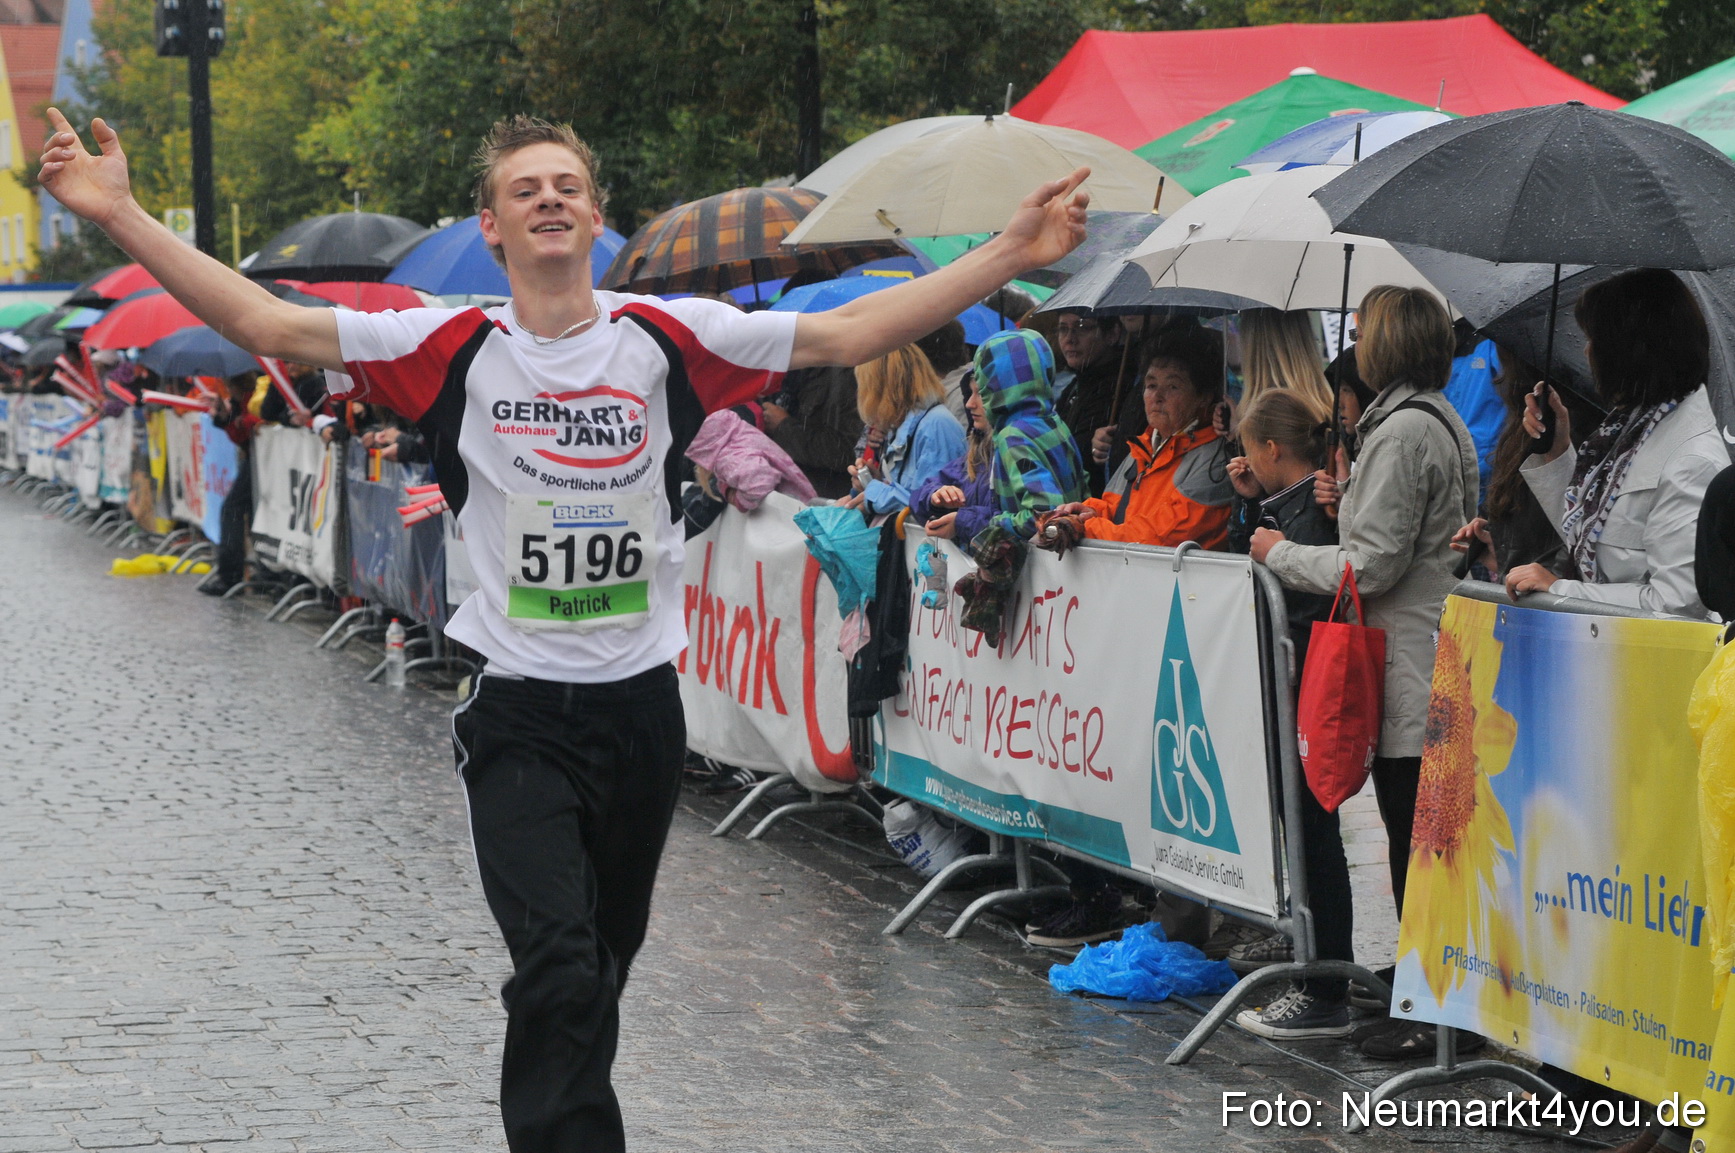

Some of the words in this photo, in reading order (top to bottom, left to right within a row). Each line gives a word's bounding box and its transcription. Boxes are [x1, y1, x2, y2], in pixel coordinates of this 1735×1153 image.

[491, 399, 624, 426] GERHART
[628, 409, 639, 421] &
[493, 423, 557, 437] Autohaus
[513, 455, 538, 478] Das
[539, 470, 607, 491] sportliche
[610, 455, 653, 490] Autohaus
[553, 505, 614, 520] BOCK
[520, 531, 643, 585] 5196
[549, 592, 611, 617] Patrick
[984, 685, 1113, 782] BESSER.
[1153, 841, 1168, 863] Jura
[1194, 855, 1219, 882] Service
[1220, 863, 1245, 889] GmbH
[1510, 968, 1570, 1009] Außenplatten
[1580, 991, 1625, 1027] Palisaden
[1632, 1009, 1667, 1041] Stufen
